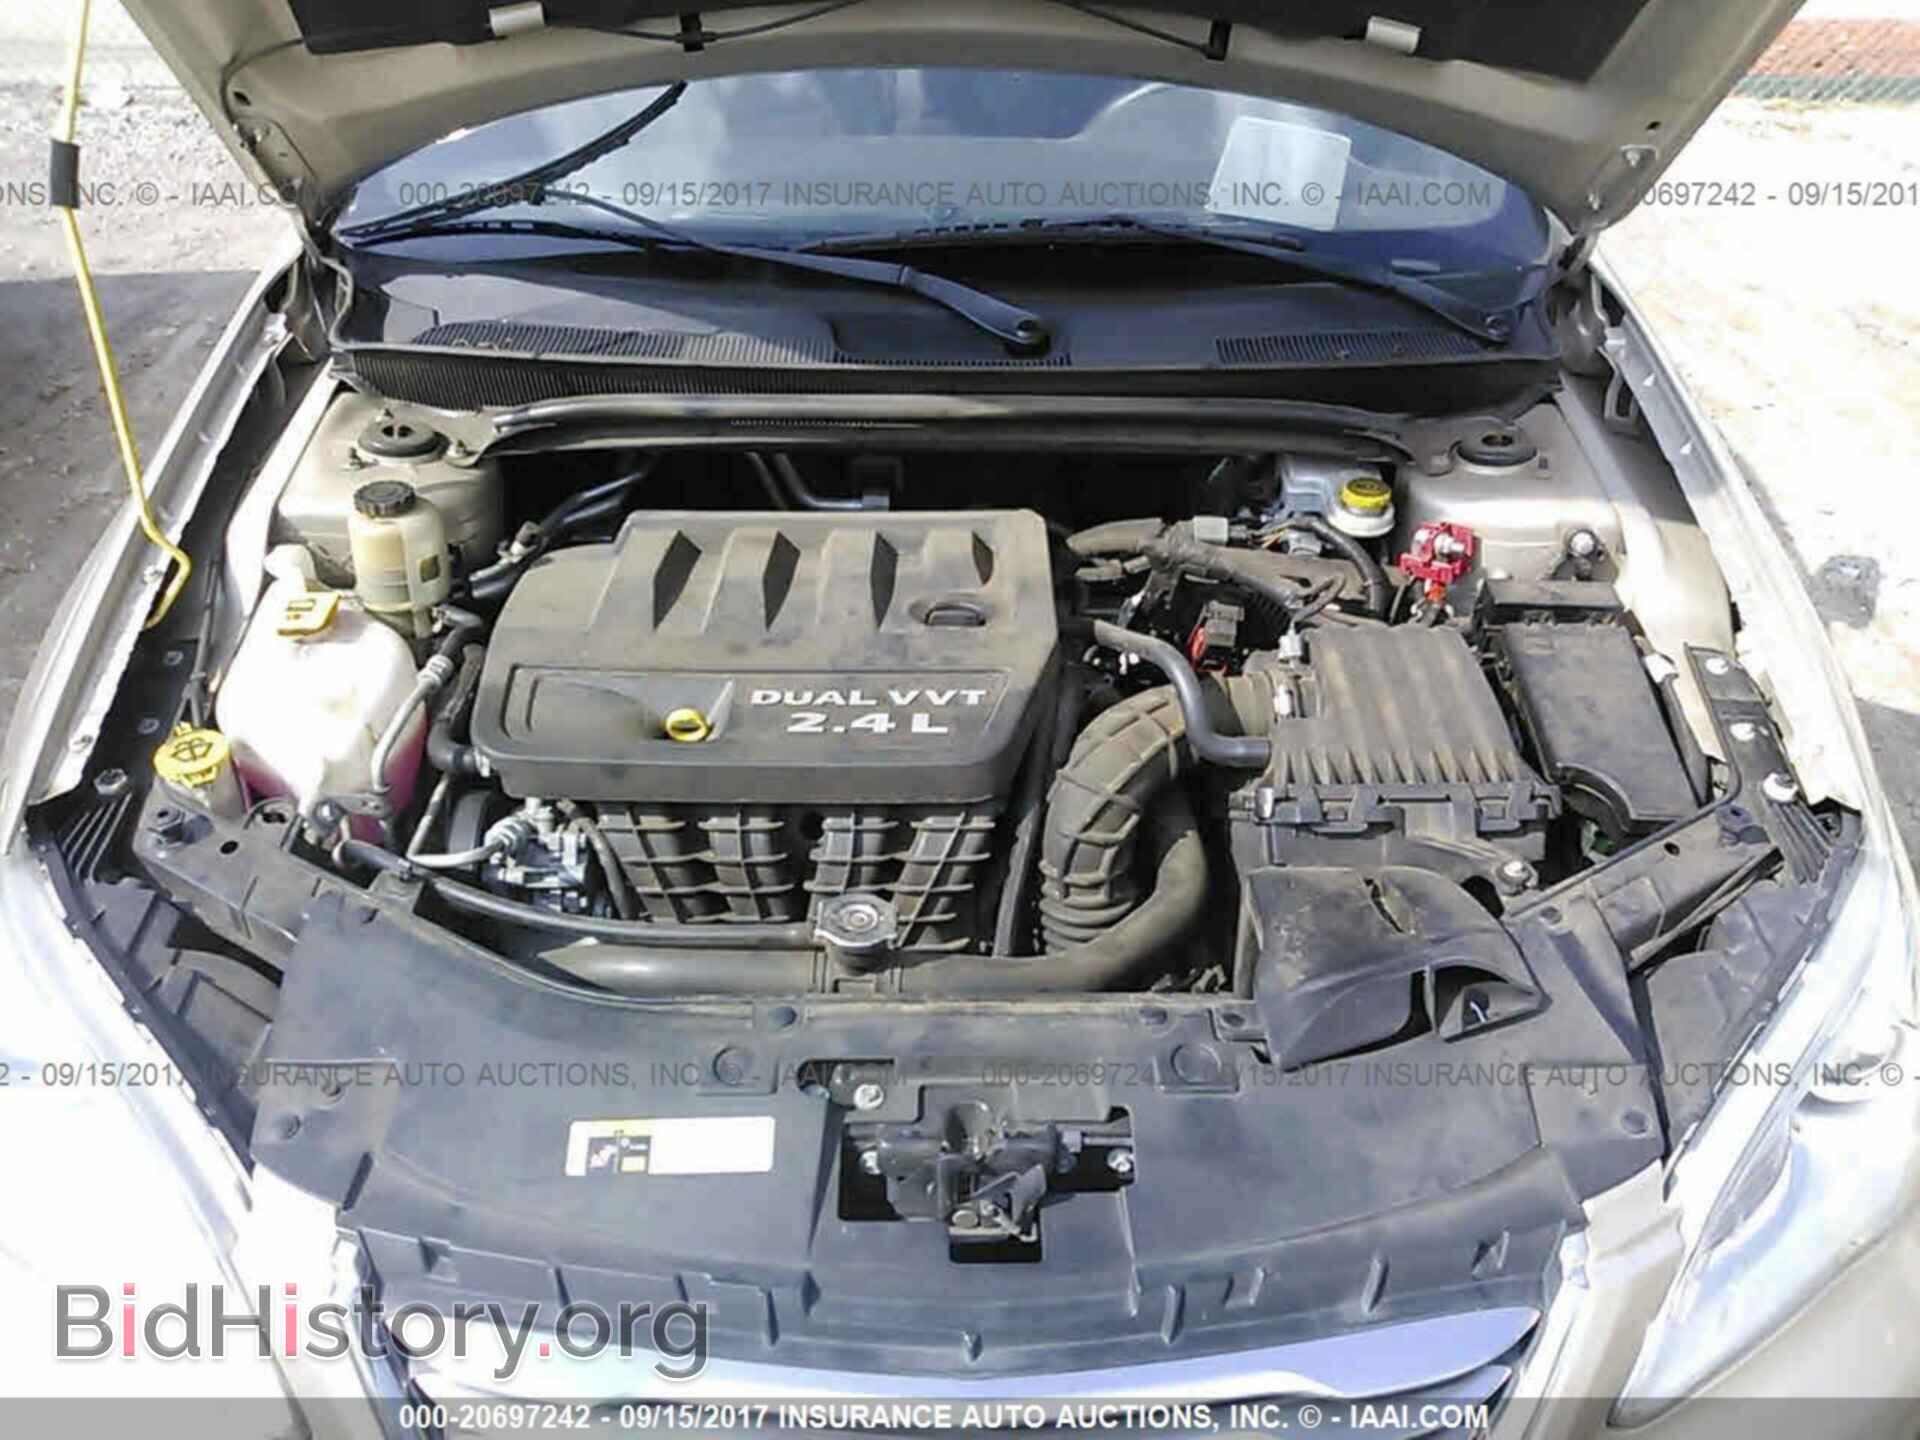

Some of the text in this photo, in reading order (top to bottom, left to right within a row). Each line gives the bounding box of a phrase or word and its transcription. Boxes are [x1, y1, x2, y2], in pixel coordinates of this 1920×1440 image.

[751, 689, 987, 706] DUAL VVT
[787, 712, 949, 734] 2.4 L
